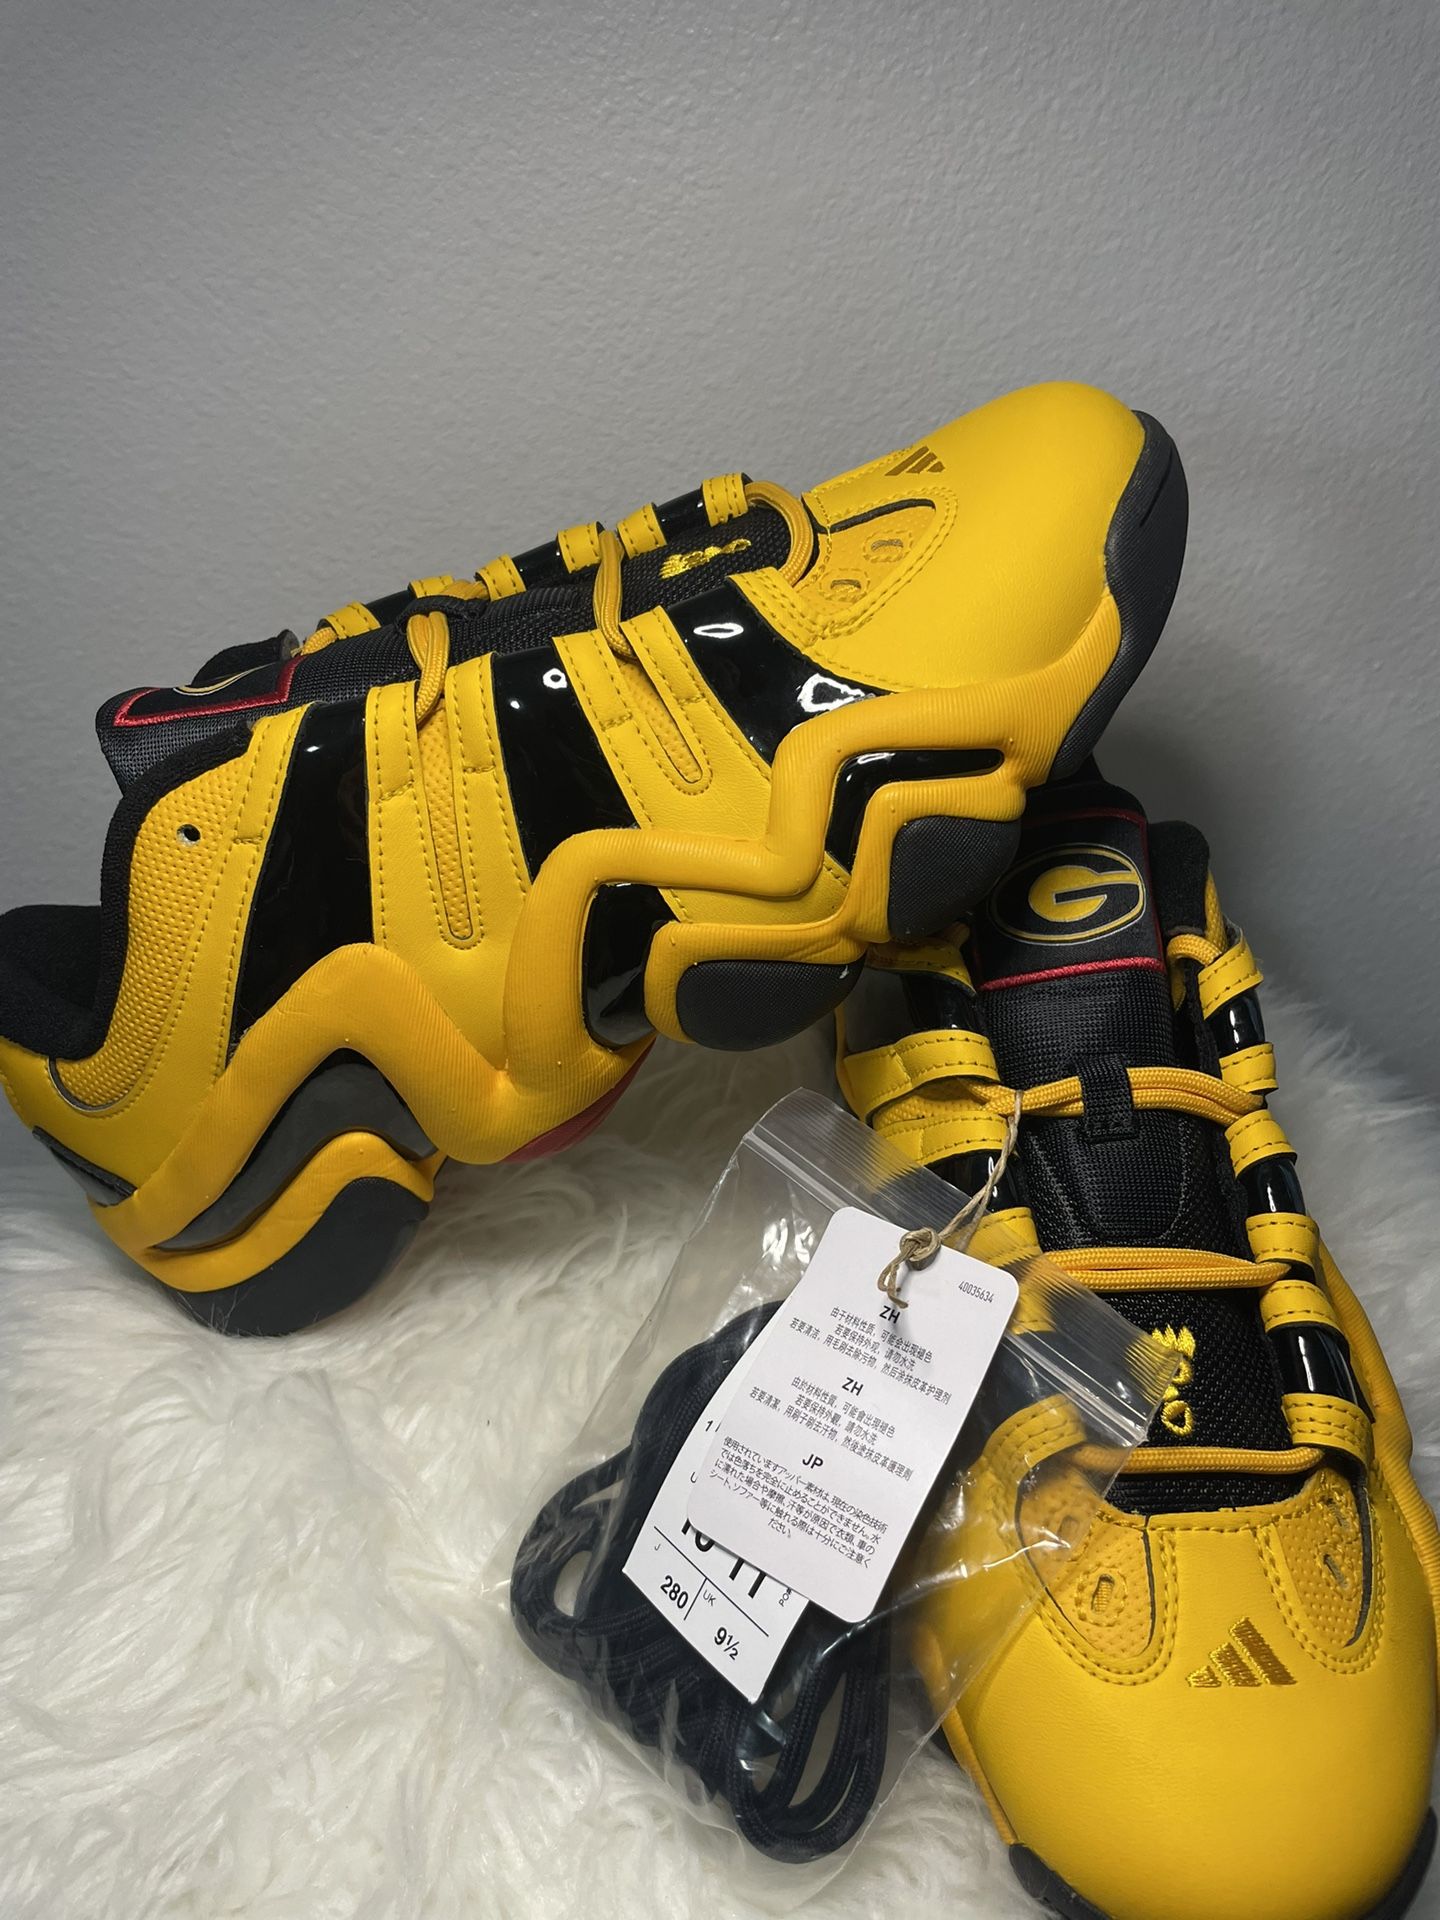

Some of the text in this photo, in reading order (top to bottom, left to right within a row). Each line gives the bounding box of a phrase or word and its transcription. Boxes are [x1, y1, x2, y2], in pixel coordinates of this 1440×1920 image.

[958, 1280, 995, 1303] 40035634
[879, 1305, 901, 1324] ZH
[842, 1377, 864, 1396] ZH
[802, 1453, 824, 1469] JP
[660, 1575, 689, 1609] 280
[702, 1589, 716, 1607] UK
